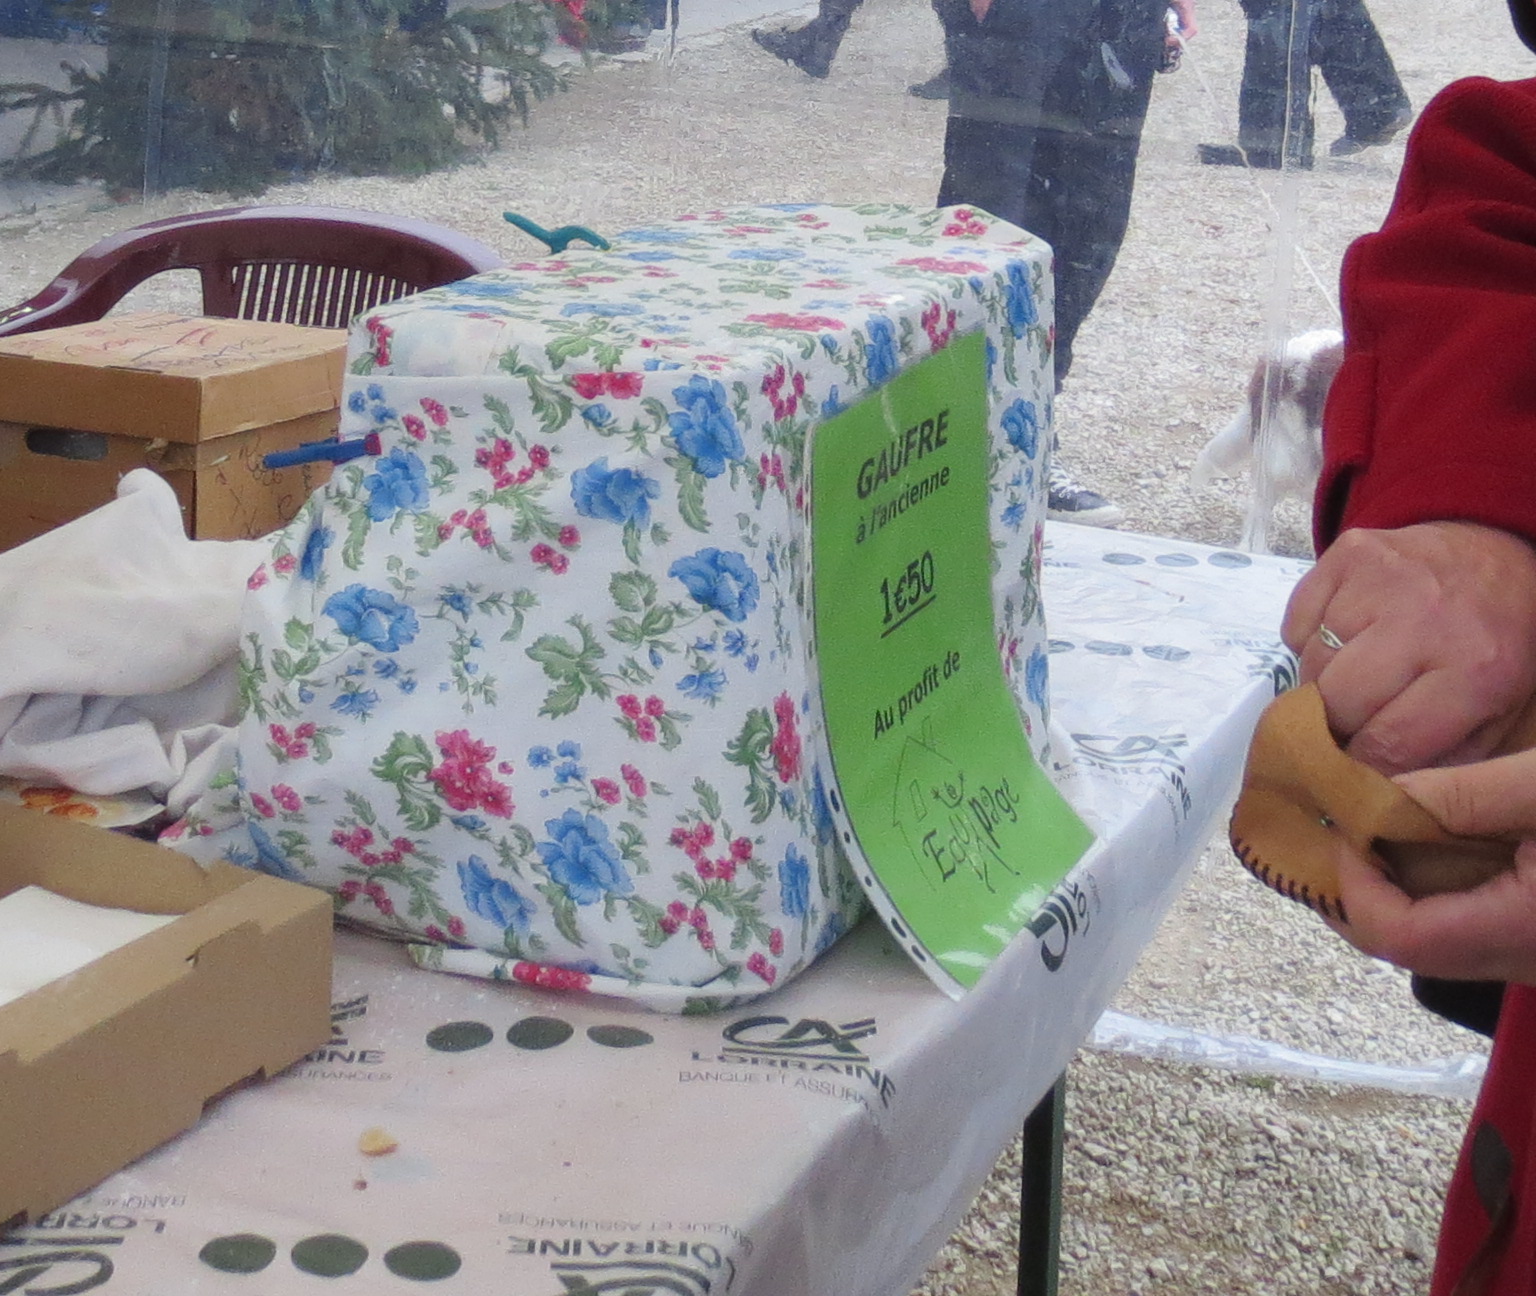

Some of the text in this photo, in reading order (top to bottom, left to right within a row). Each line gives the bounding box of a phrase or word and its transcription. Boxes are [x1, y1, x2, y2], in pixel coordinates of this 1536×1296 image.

[857, 408, 949, 500] GAUFRE
[855, 466, 951, 544] à l'ancienne
[880, 550, 935, 624] 1€50
[874, 651, 961, 740] Au profit de
[1053, 757, 1192, 821] LORRAINE
[690, 1051, 896, 1109] LORRAINE
